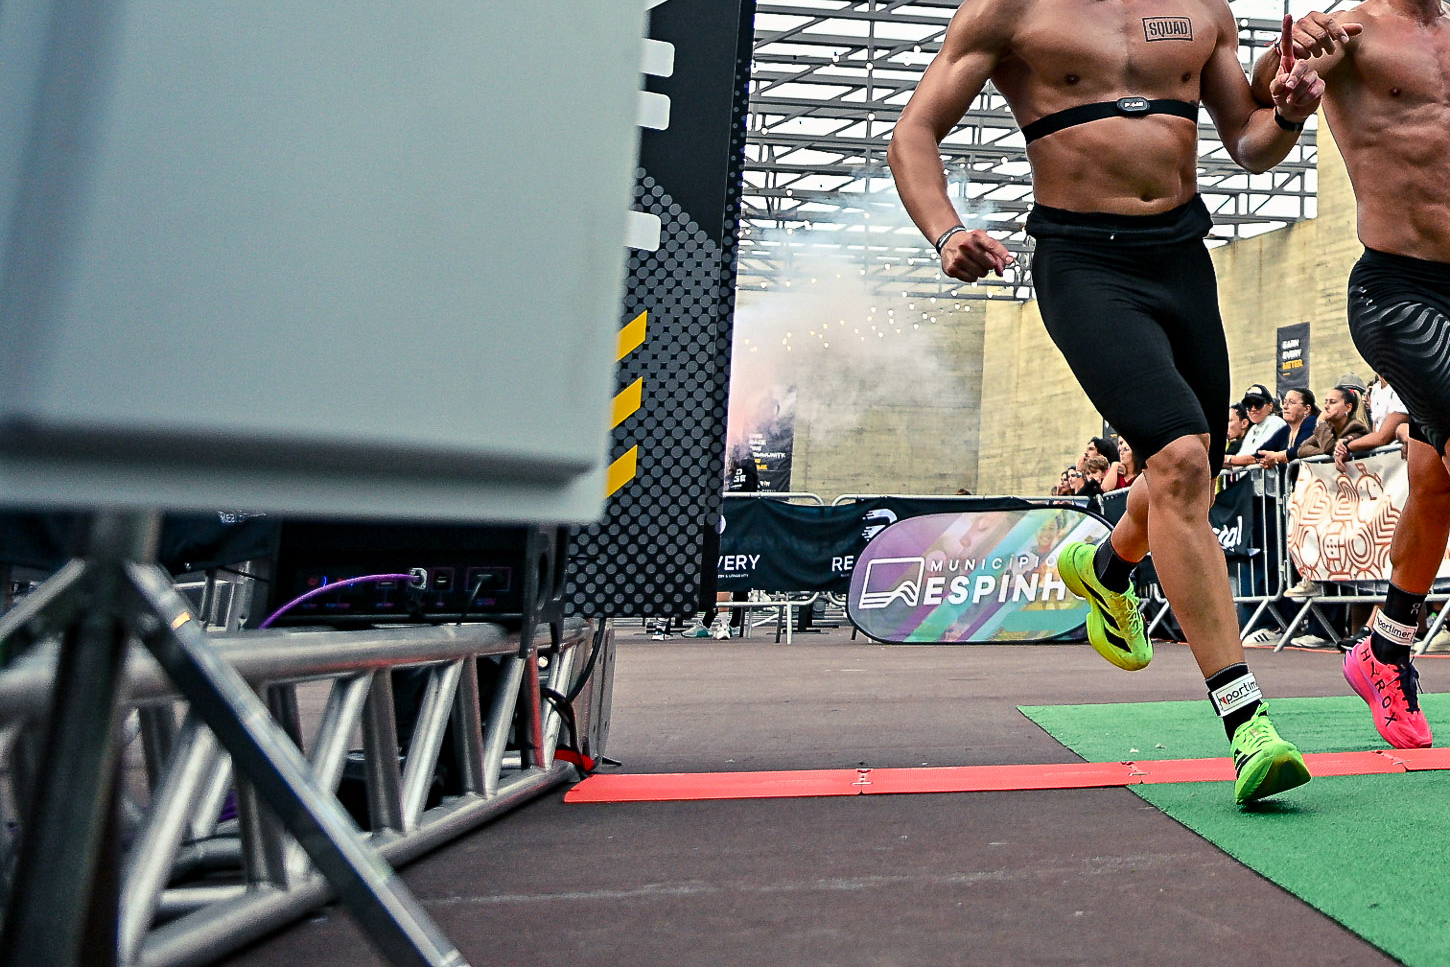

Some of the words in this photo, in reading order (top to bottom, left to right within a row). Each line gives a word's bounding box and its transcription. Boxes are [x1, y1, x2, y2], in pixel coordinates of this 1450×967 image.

[1148, 21, 1188, 37] SQUAD
[930, 554, 1058, 573] MUNICÍPIO
[923, 571, 1088, 606] ESPINH
[1361, 648, 1398, 727] HYROX
